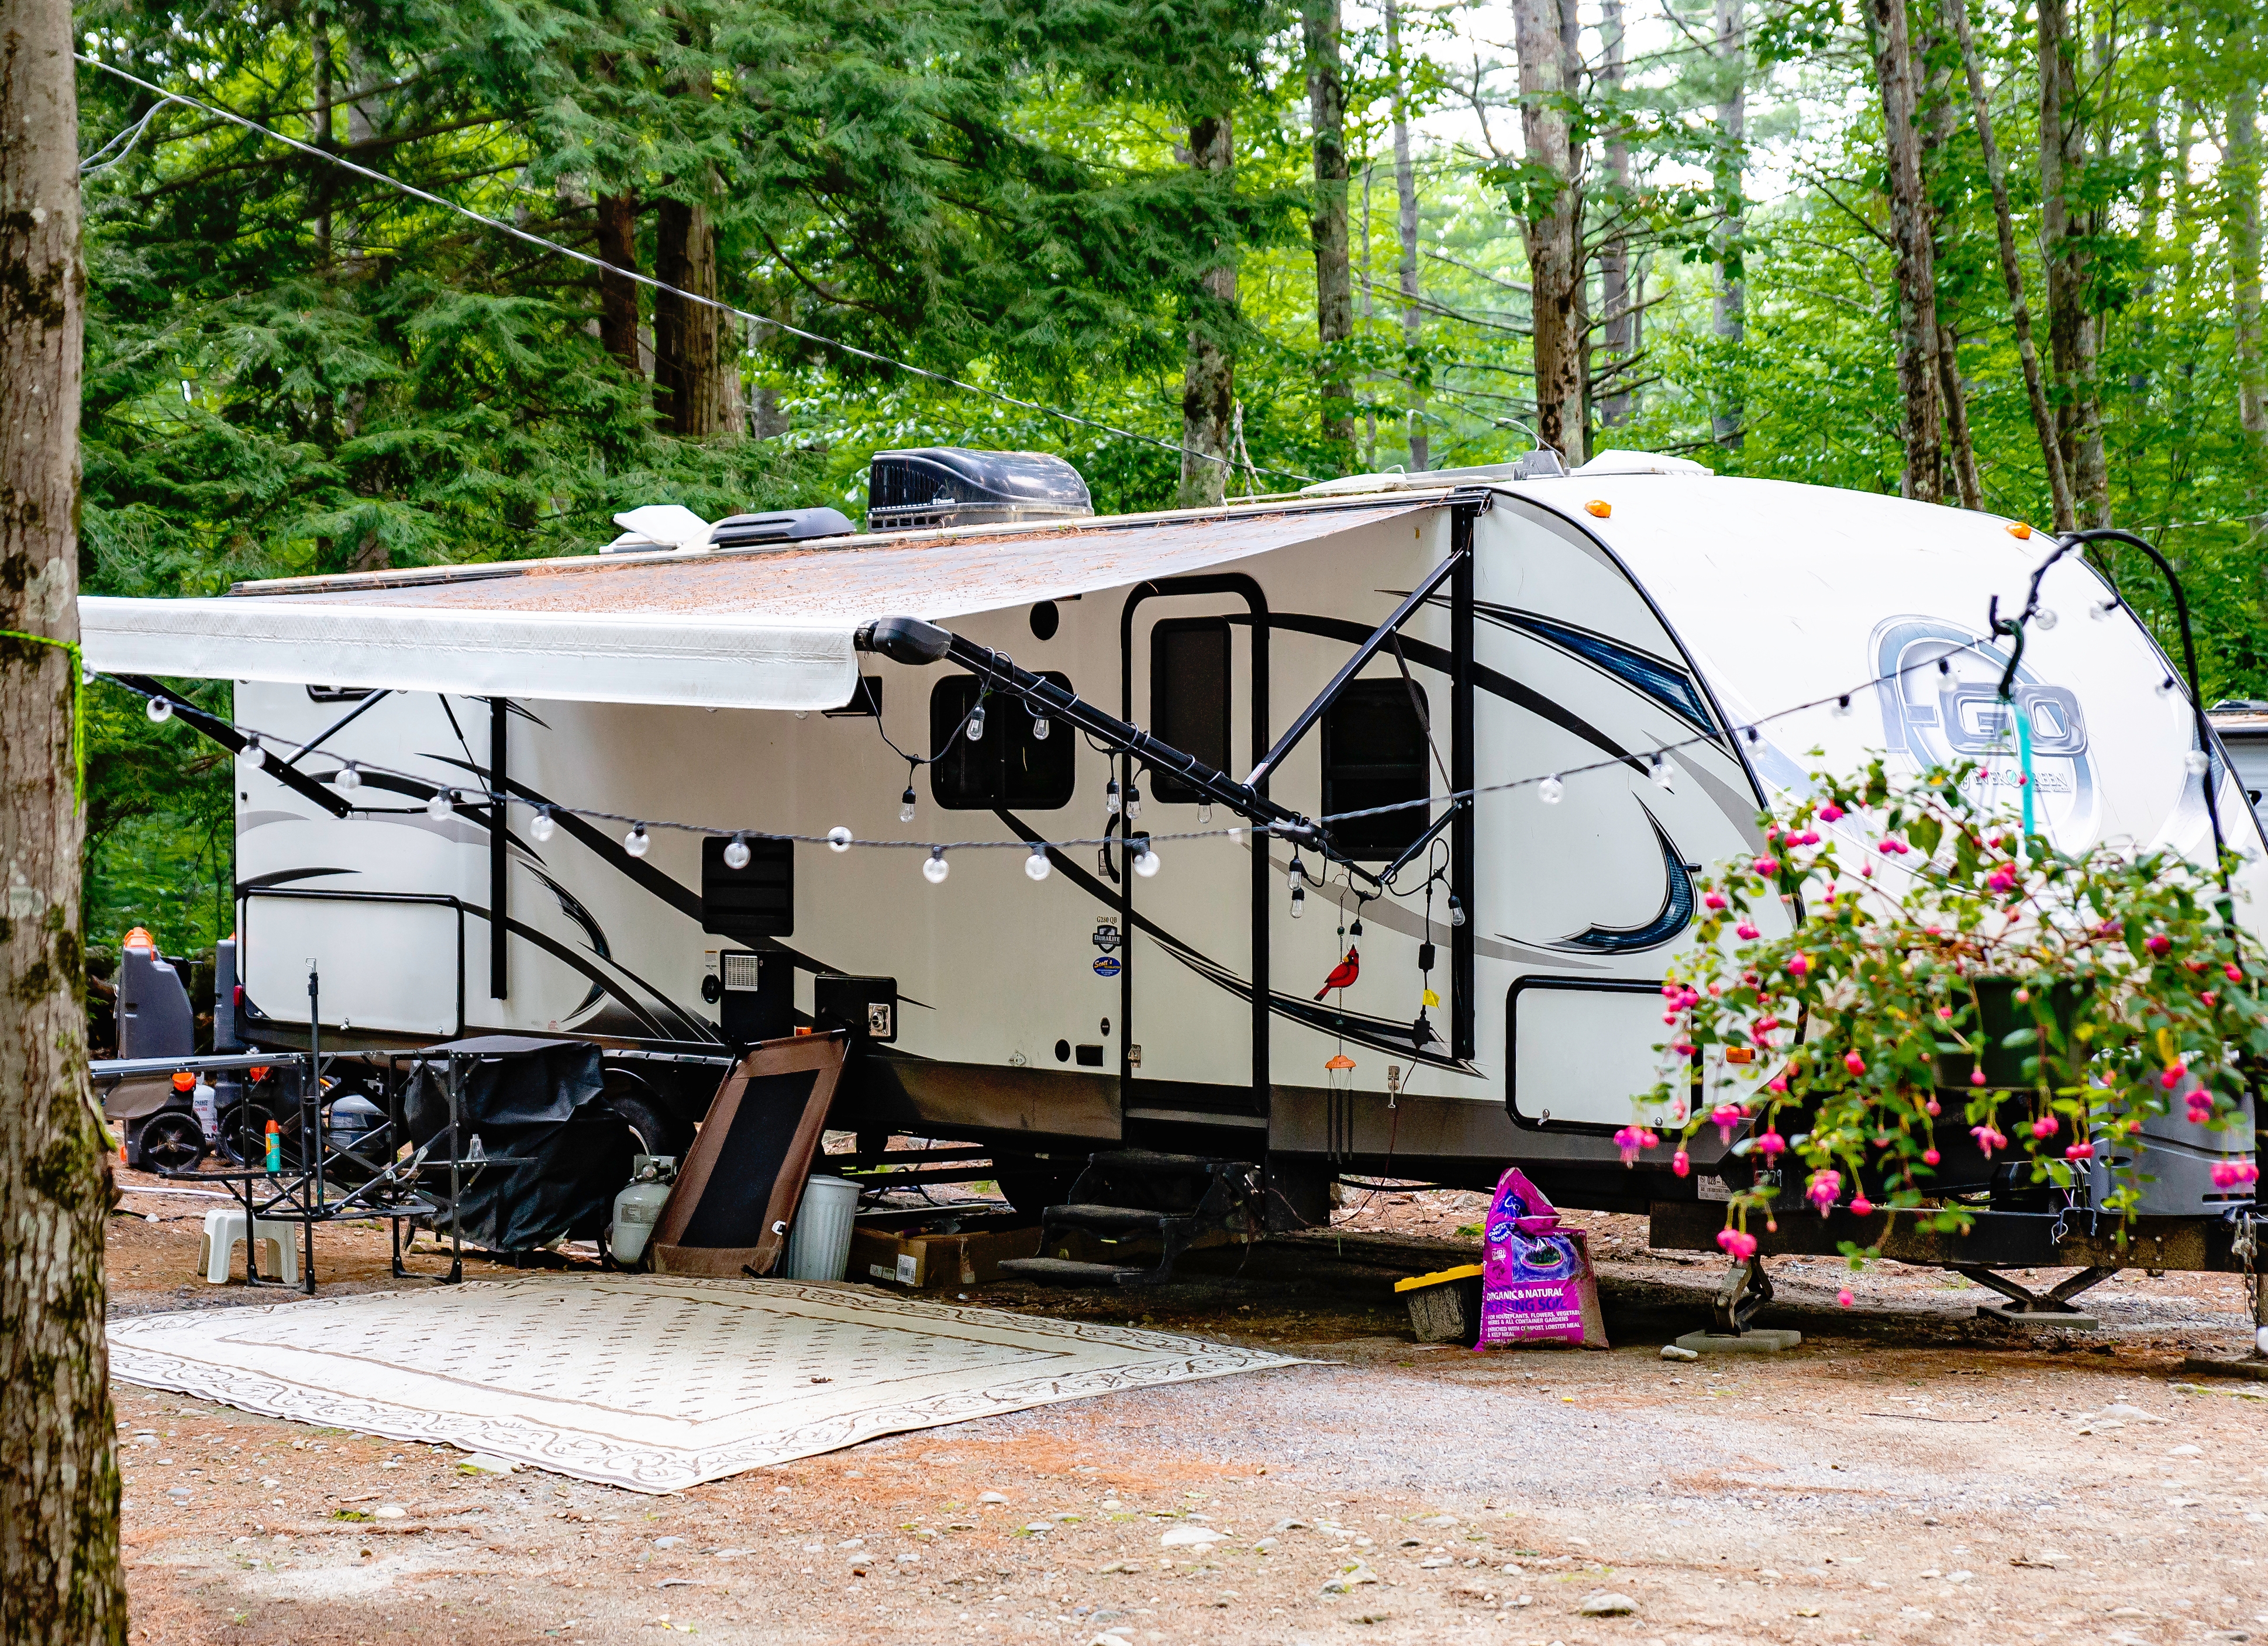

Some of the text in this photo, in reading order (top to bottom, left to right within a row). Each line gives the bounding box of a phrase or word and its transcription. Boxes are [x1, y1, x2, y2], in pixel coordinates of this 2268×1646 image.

[1094, 958, 1112, 968] Scott's
[1487, 1290, 1518, 1301] ORGANIC
[1518, 1290, 1525, 1299] &
[1525, 1288, 1564, 1298] NATURAL
[1538, 1297, 1567, 1311] SOIL
